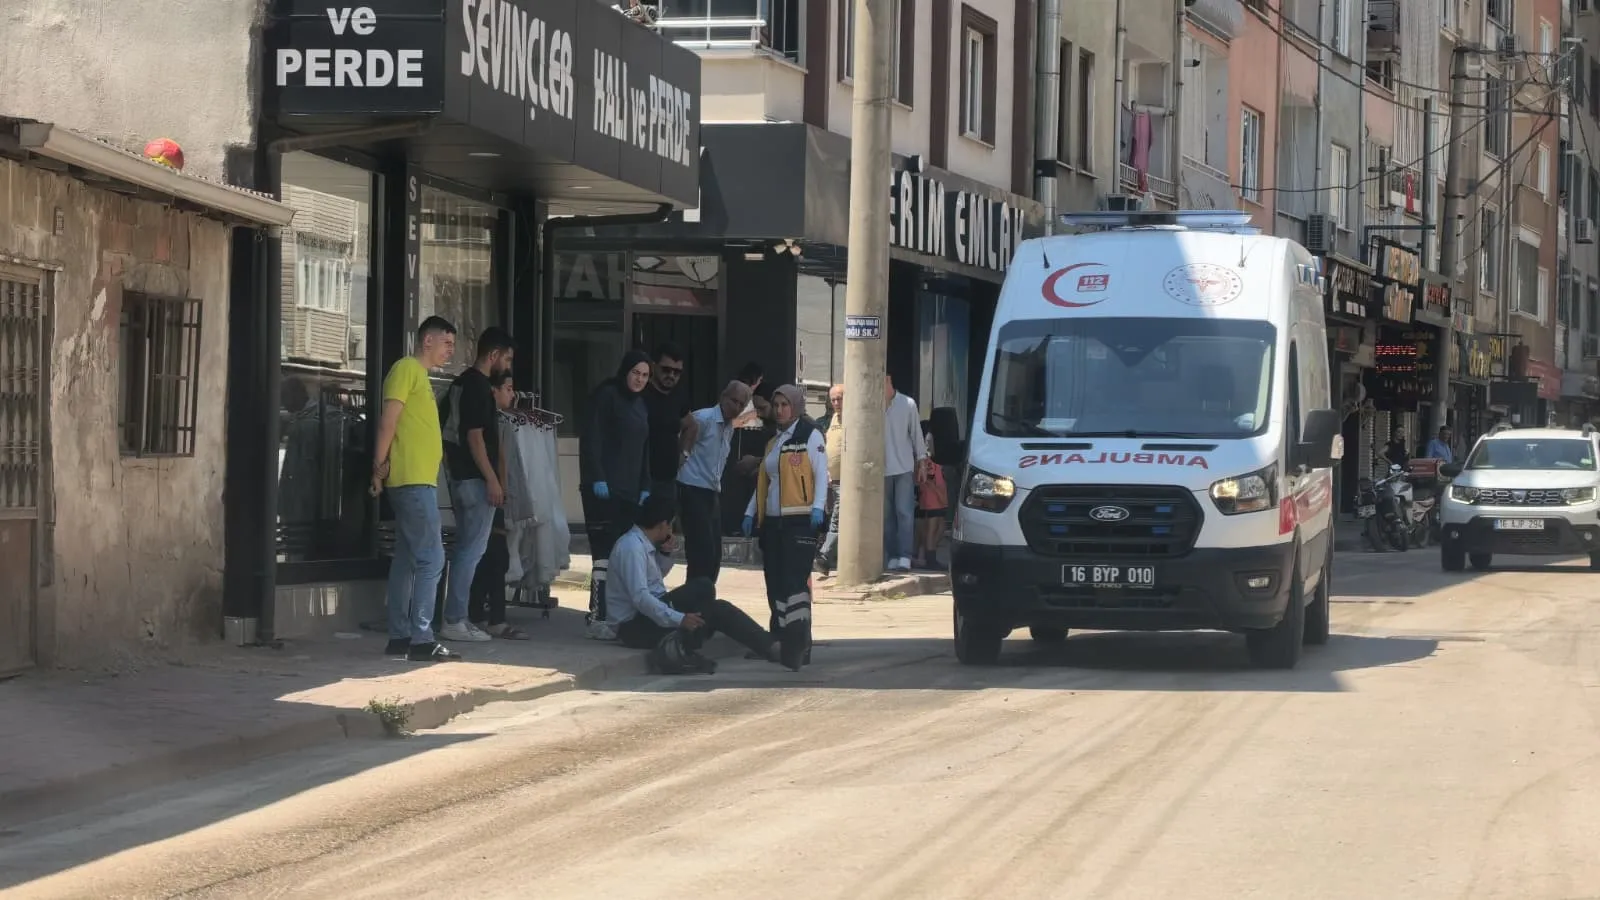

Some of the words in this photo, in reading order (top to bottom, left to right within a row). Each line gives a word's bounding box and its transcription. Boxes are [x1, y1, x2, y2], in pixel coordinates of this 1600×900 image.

[328, 5, 377, 36] ve
[276, 49, 424, 88] PERDE
[593, 48, 627, 142] HALI
[631, 87, 647, 149] ve
[649, 74, 691, 167] PERDE
[1083, 276, 1105, 286] 112
[1096, 508, 1122, 518] Ford
[1071, 566, 1086, 582] 16
[1093, 567, 1119, 582] BYP
[1128, 567, 1152, 583] 010
